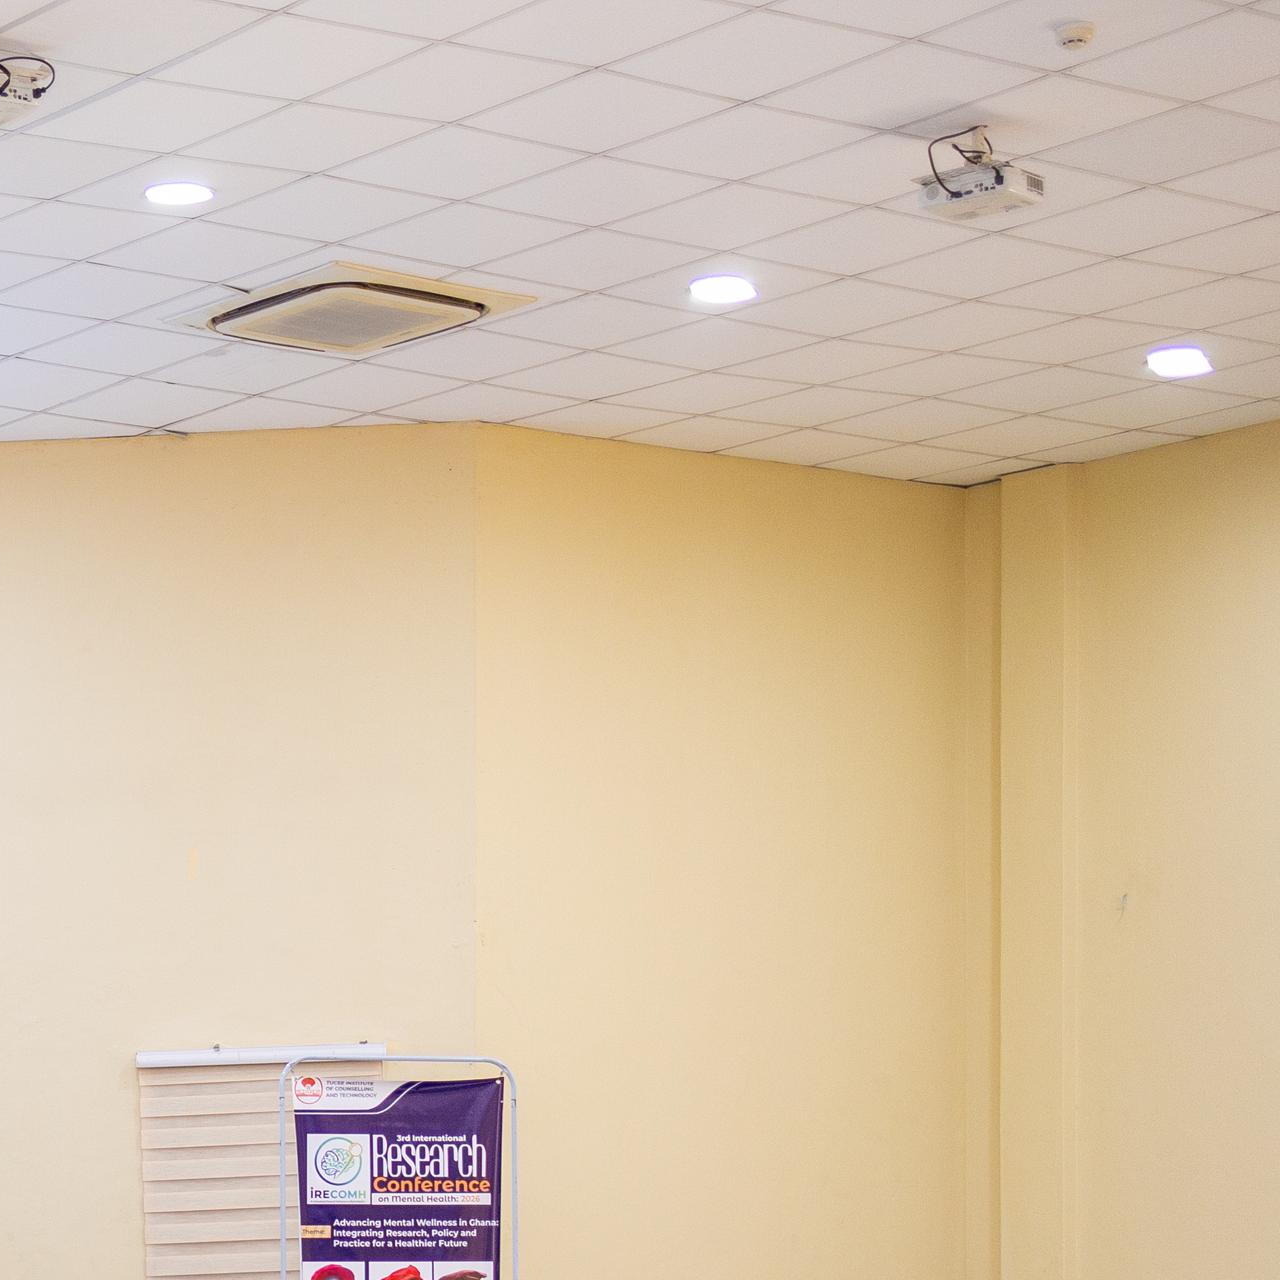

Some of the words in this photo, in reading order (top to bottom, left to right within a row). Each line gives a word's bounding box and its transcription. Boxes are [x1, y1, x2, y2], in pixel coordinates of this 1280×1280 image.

[372, 1135, 486, 1177] Research
[373, 1177, 490, 1192] Conference
[392, 1195, 424, 1203] Mental
[333, 1219, 381, 1228] Advancing
[469, 1219, 499, 1227] Ghana:
[333, 1229, 384, 1238] Integrating
[386, 1229, 429, 1238] Research,
[432, 1229, 458, 1238] Policy
[461, 1229, 476, 1237] and
[333, 1240, 370, 1248] Practice
[372, 1239, 385, 1247] for
[395, 1239, 436, 1247] Healthier
